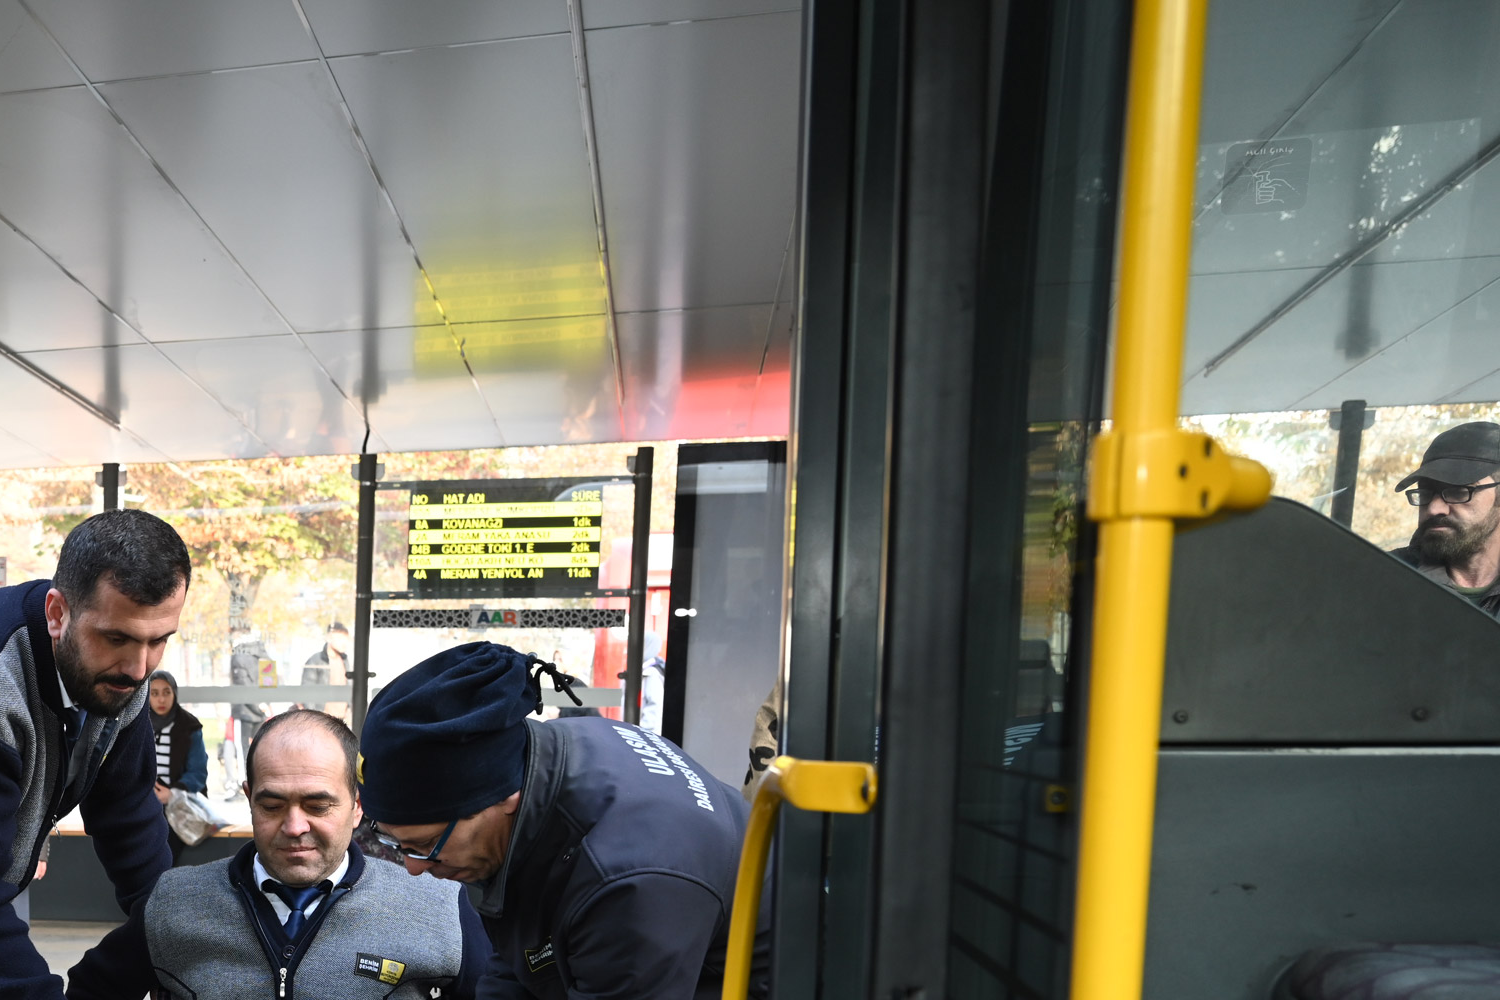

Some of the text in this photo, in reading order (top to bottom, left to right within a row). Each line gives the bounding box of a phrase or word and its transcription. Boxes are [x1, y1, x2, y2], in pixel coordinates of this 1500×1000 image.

[412, 489, 601, 505] NO HAT ADI SÜRE
[572, 517, 592, 527] 1dk
[484, 531, 511, 540] YAKA
[571, 542, 590, 553] 2dk
[413, 568, 428, 580] 4A
[441, 568, 479, 580] MERAM
[527, 568, 544, 579] AN
[567, 567, 592, 578] 11dk
[612, 725, 676, 776] ULAŞIM
